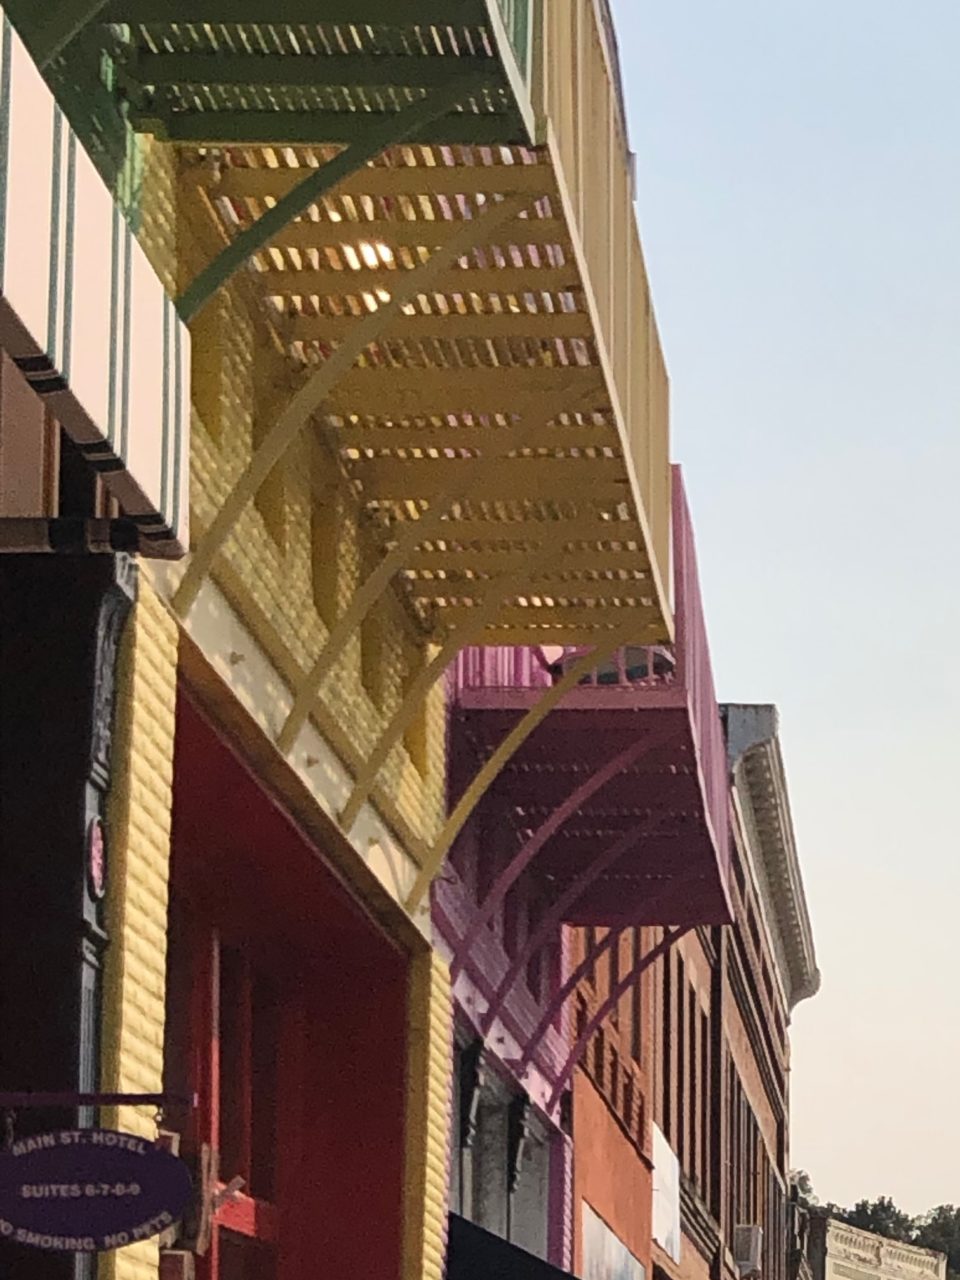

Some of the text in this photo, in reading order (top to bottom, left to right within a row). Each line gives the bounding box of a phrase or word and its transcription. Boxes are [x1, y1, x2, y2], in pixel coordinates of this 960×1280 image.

[12, 1133, 56, 1156] MAIN
[92, 1132, 147, 1155] HOTEL
[22, 1183, 81, 1198] SUITES
[16, 1227, 96, 1250] SMOKING
[104, 1231, 128, 1248] NO
[132, 1210, 173, 1240] PETS
